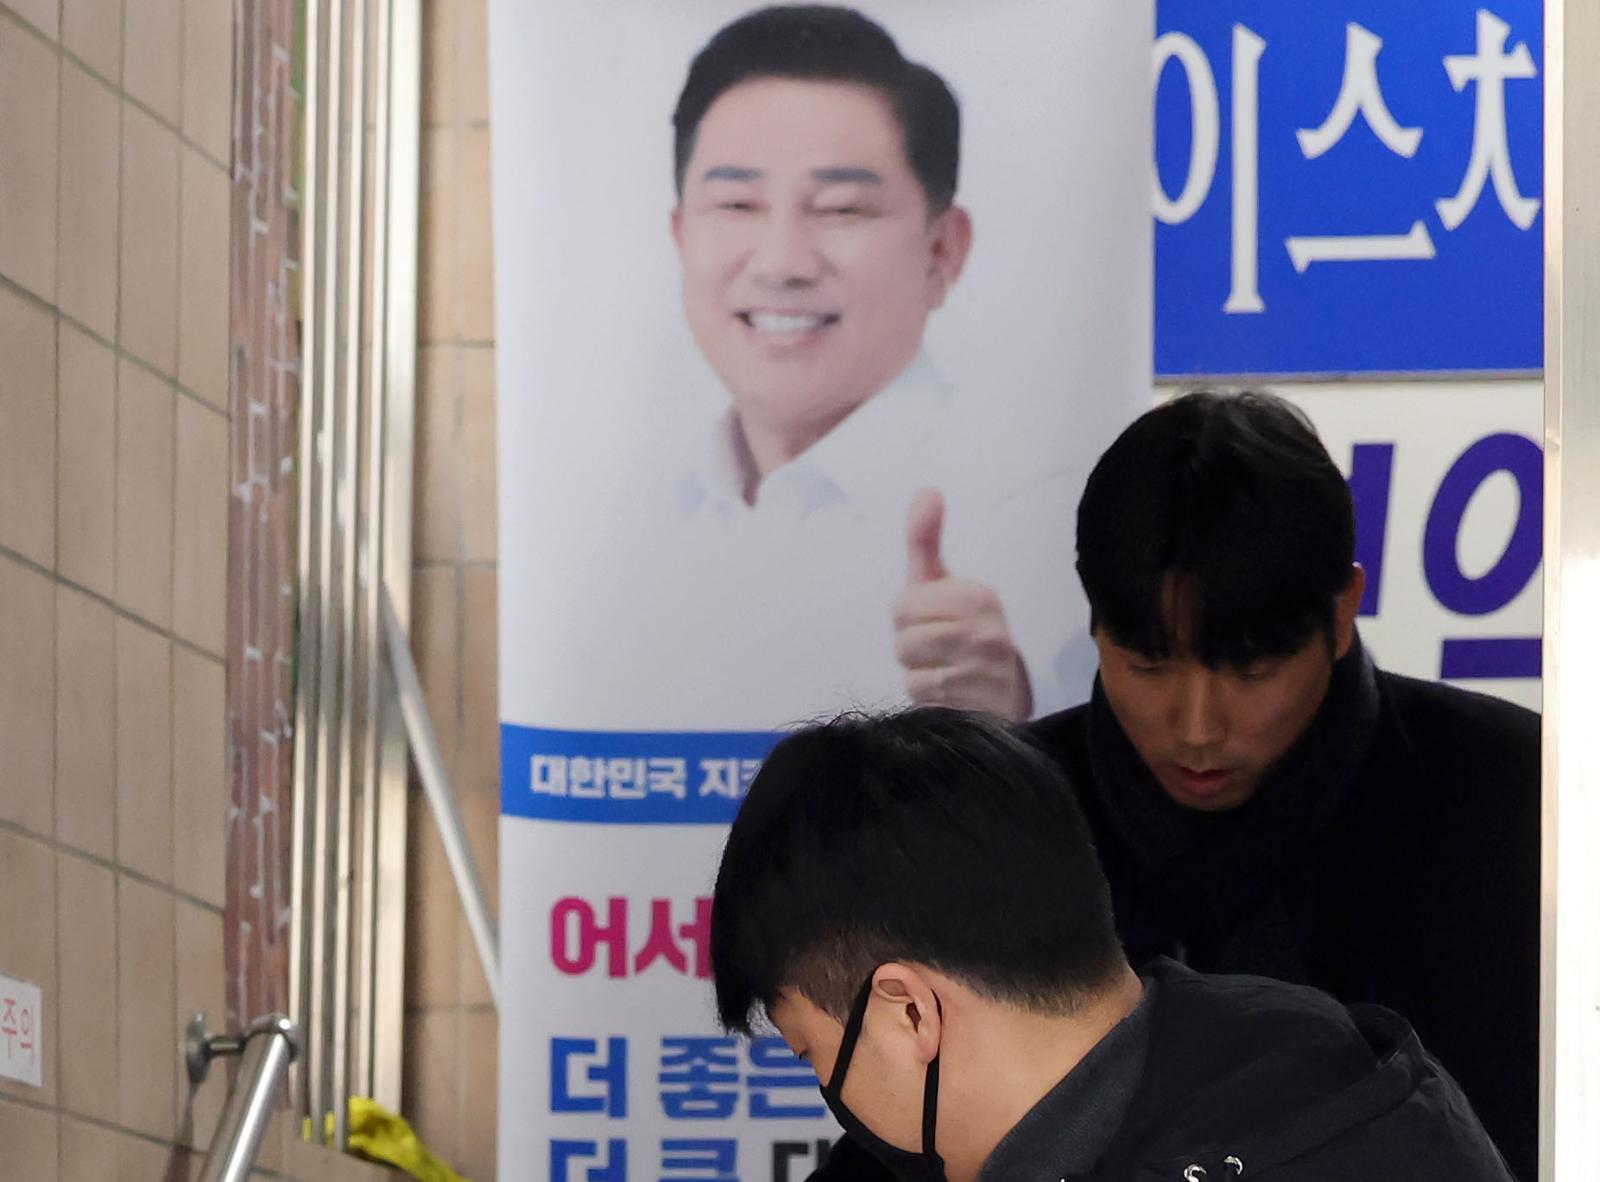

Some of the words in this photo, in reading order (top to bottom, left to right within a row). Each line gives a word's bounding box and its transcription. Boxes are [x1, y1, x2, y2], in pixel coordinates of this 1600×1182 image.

[530, 754, 686, 800] 대한민국
[549, 1036, 628, 1119] 더
[658, 1036, 828, 1120] 좋은
